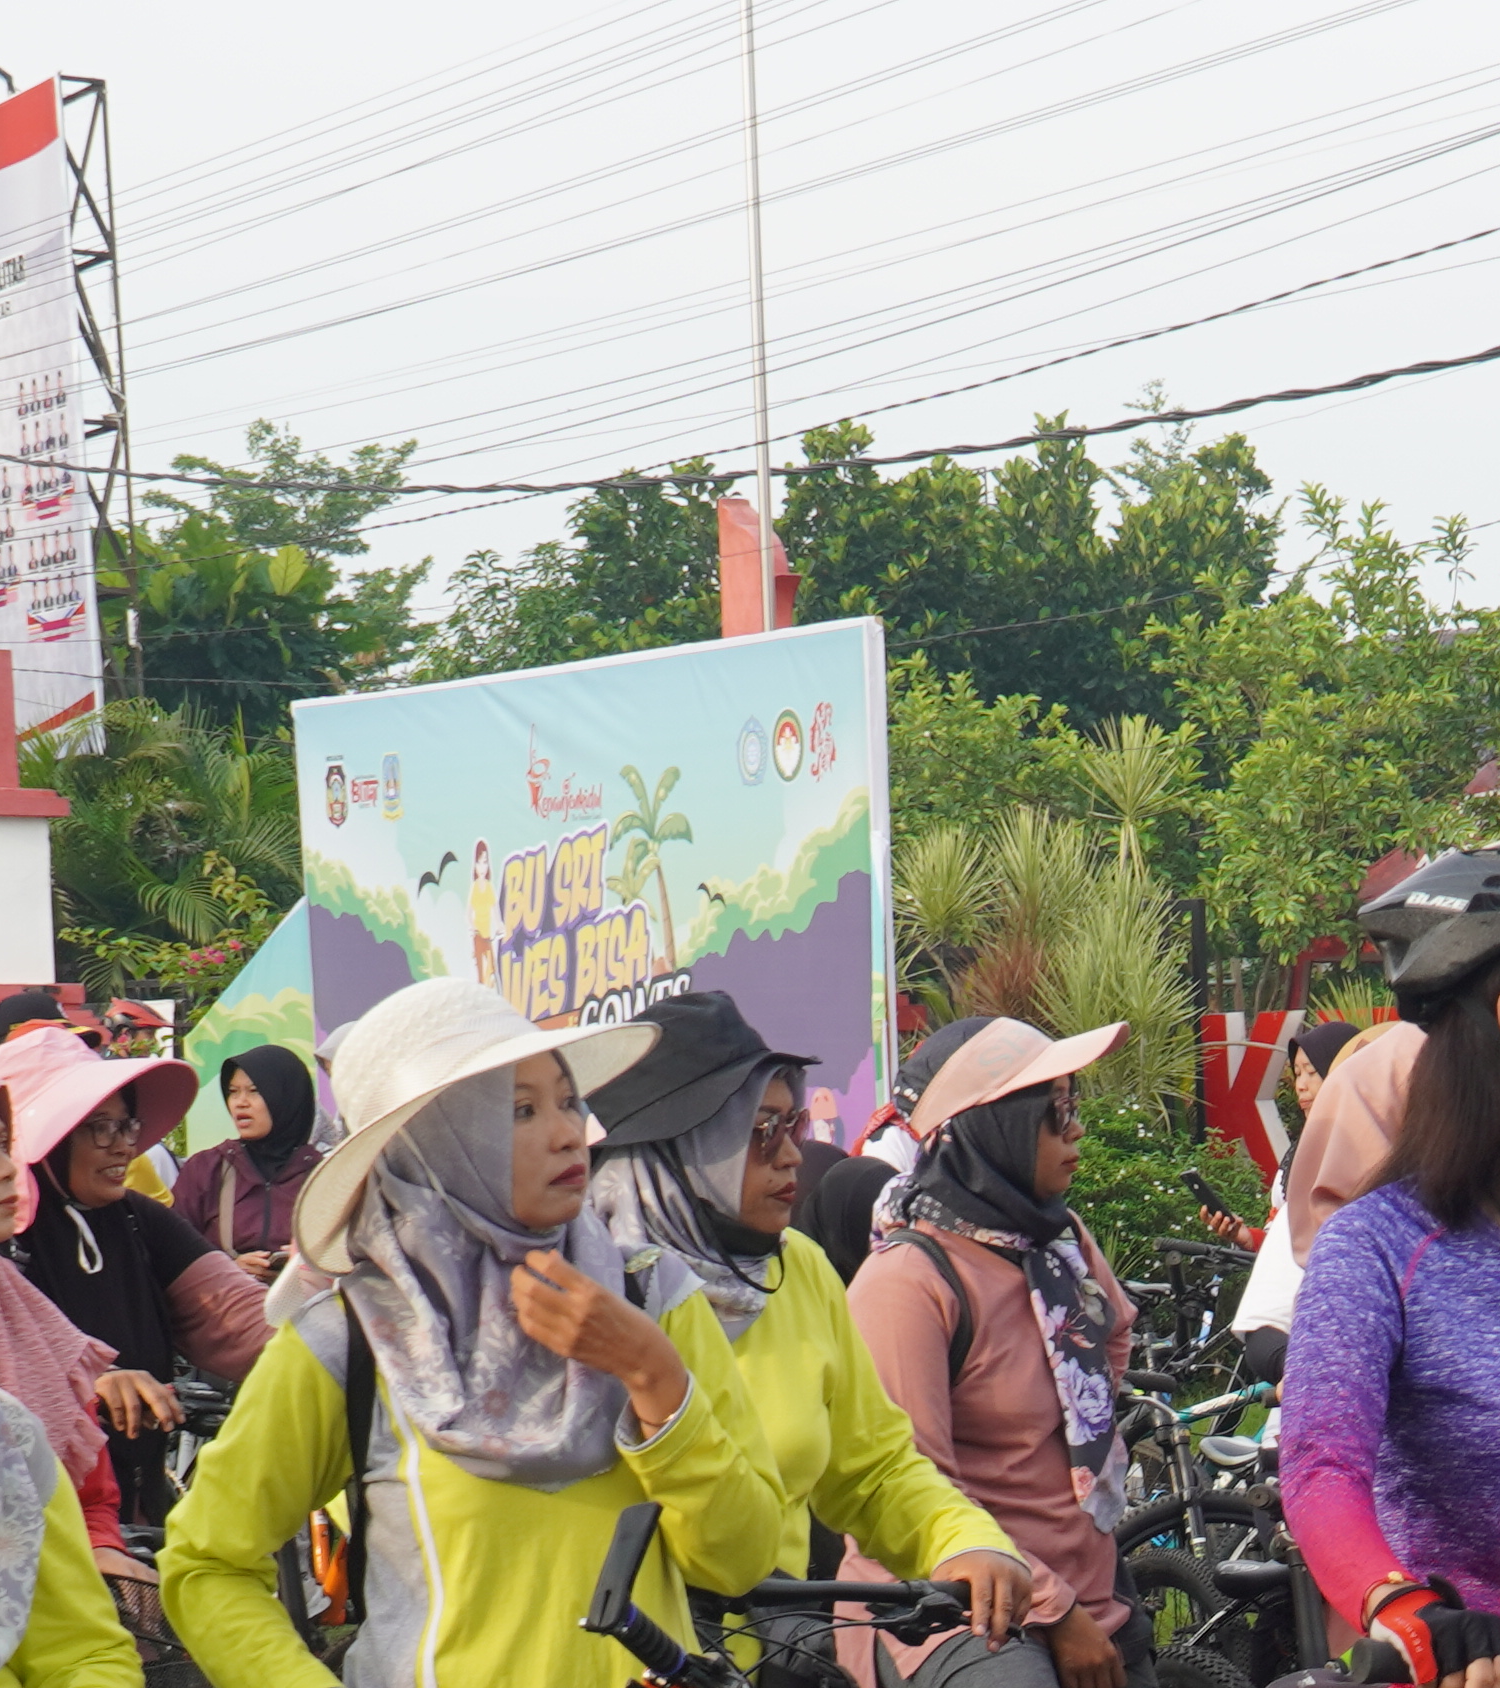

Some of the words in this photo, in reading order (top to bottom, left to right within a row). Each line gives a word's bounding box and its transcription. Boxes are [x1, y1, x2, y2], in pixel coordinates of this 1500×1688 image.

[501, 847, 548, 946] BU
[553, 825, 607, 929] SRI
[1404, 890, 1470, 913] BLAZE
[574, 903, 649, 1008] BISA
